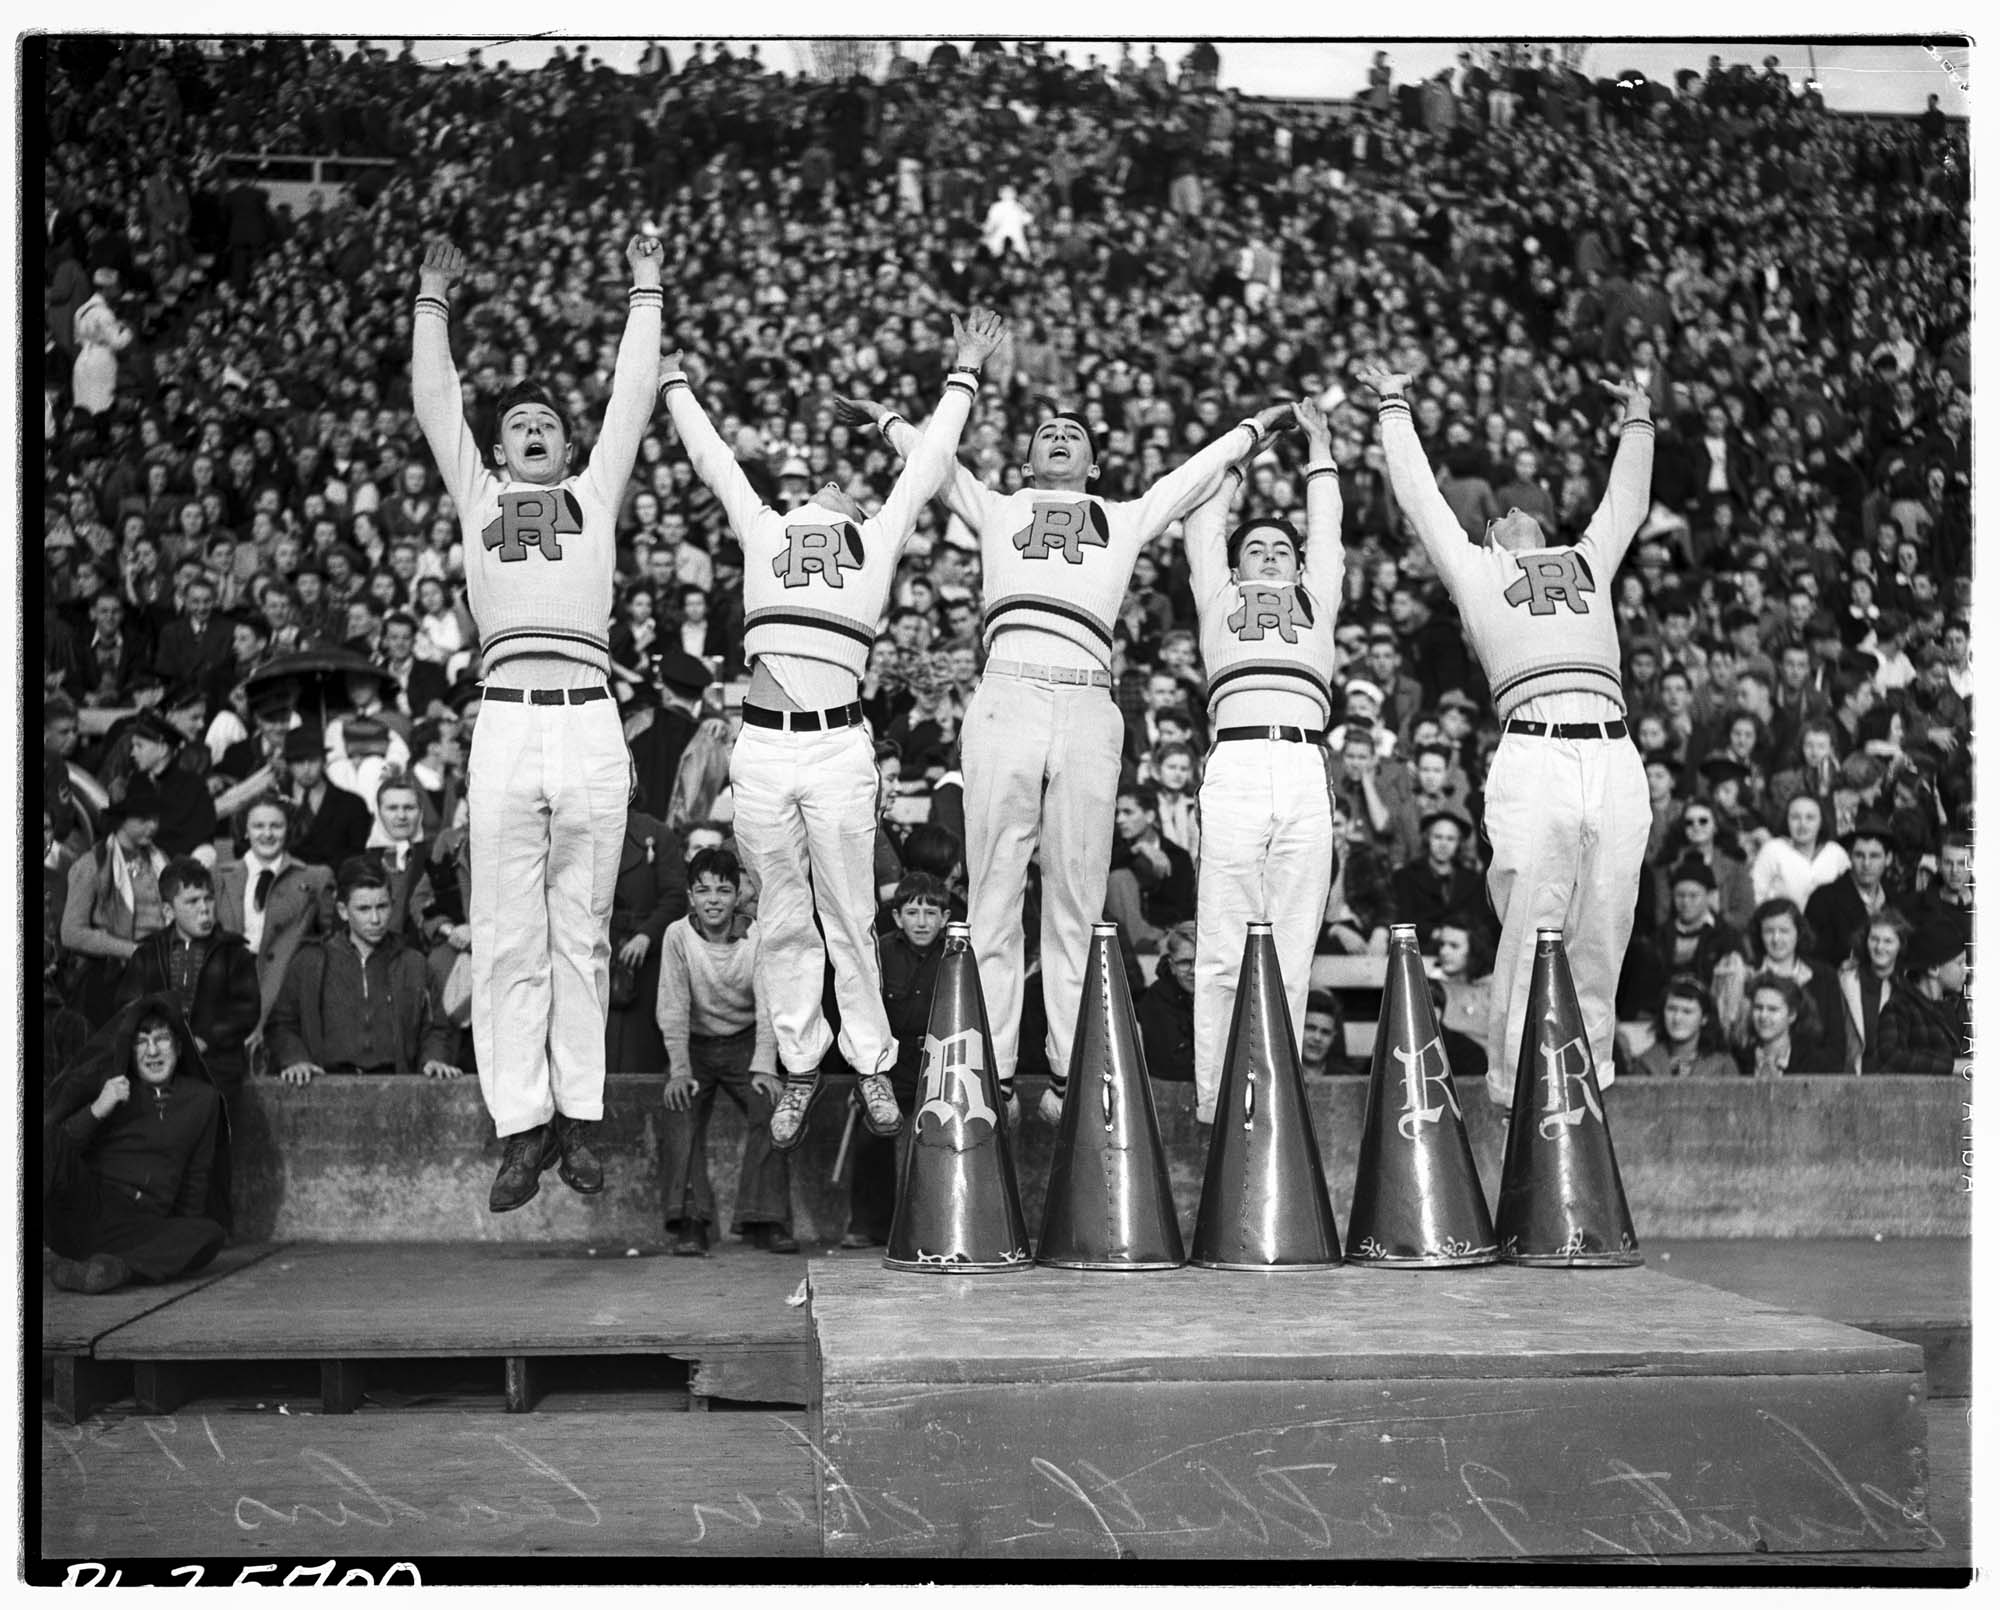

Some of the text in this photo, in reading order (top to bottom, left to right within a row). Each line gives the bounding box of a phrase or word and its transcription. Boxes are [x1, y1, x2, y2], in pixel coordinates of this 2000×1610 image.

[498, 490, 562, 562] R
[784, 524, 844, 588] R
[1022, 502, 1084, 564] R
[1238, 585, 1298, 644] R
[1516, 555, 1590, 616] R
[915, 1027, 998, 1134] R
[1393, 1036, 1462, 1140] R
[1539, 1036, 1603, 1140] R
